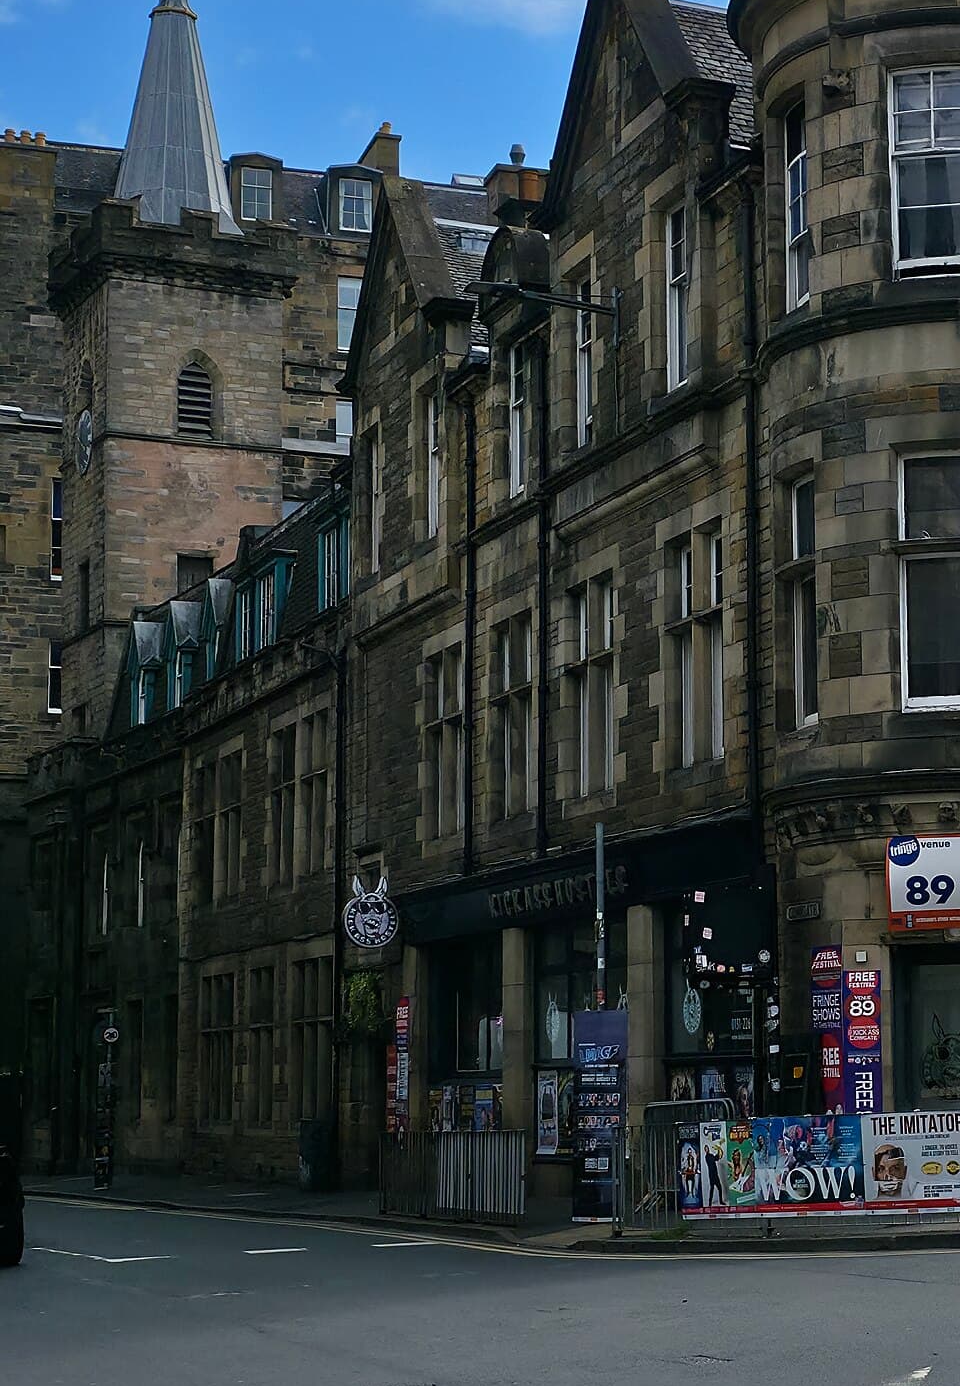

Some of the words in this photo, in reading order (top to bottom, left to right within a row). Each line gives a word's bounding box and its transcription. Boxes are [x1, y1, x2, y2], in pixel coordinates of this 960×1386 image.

[890, 839, 918, 856] fringe
[921, 840, 951, 849] venue
[906, 874, 955, 906] 89
[815, 950, 839, 961] FREE
[811, 959, 842, 970] FESTIVAL
[848, 971, 876, 983] FREE
[848, 981, 876, 989] FESTIVAL
[812, 994, 840, 1008] FRINGE
[849, 1000, 875, 1017] 89
[812, 1007, 841, 1022] SHOWS
[821, 1047, 840, 1066] REE
[855, 1071, 874, 1109] FREE
[870, 1116, 896, 1136] THE
[755, 1165, 856, 1201] WOW!
